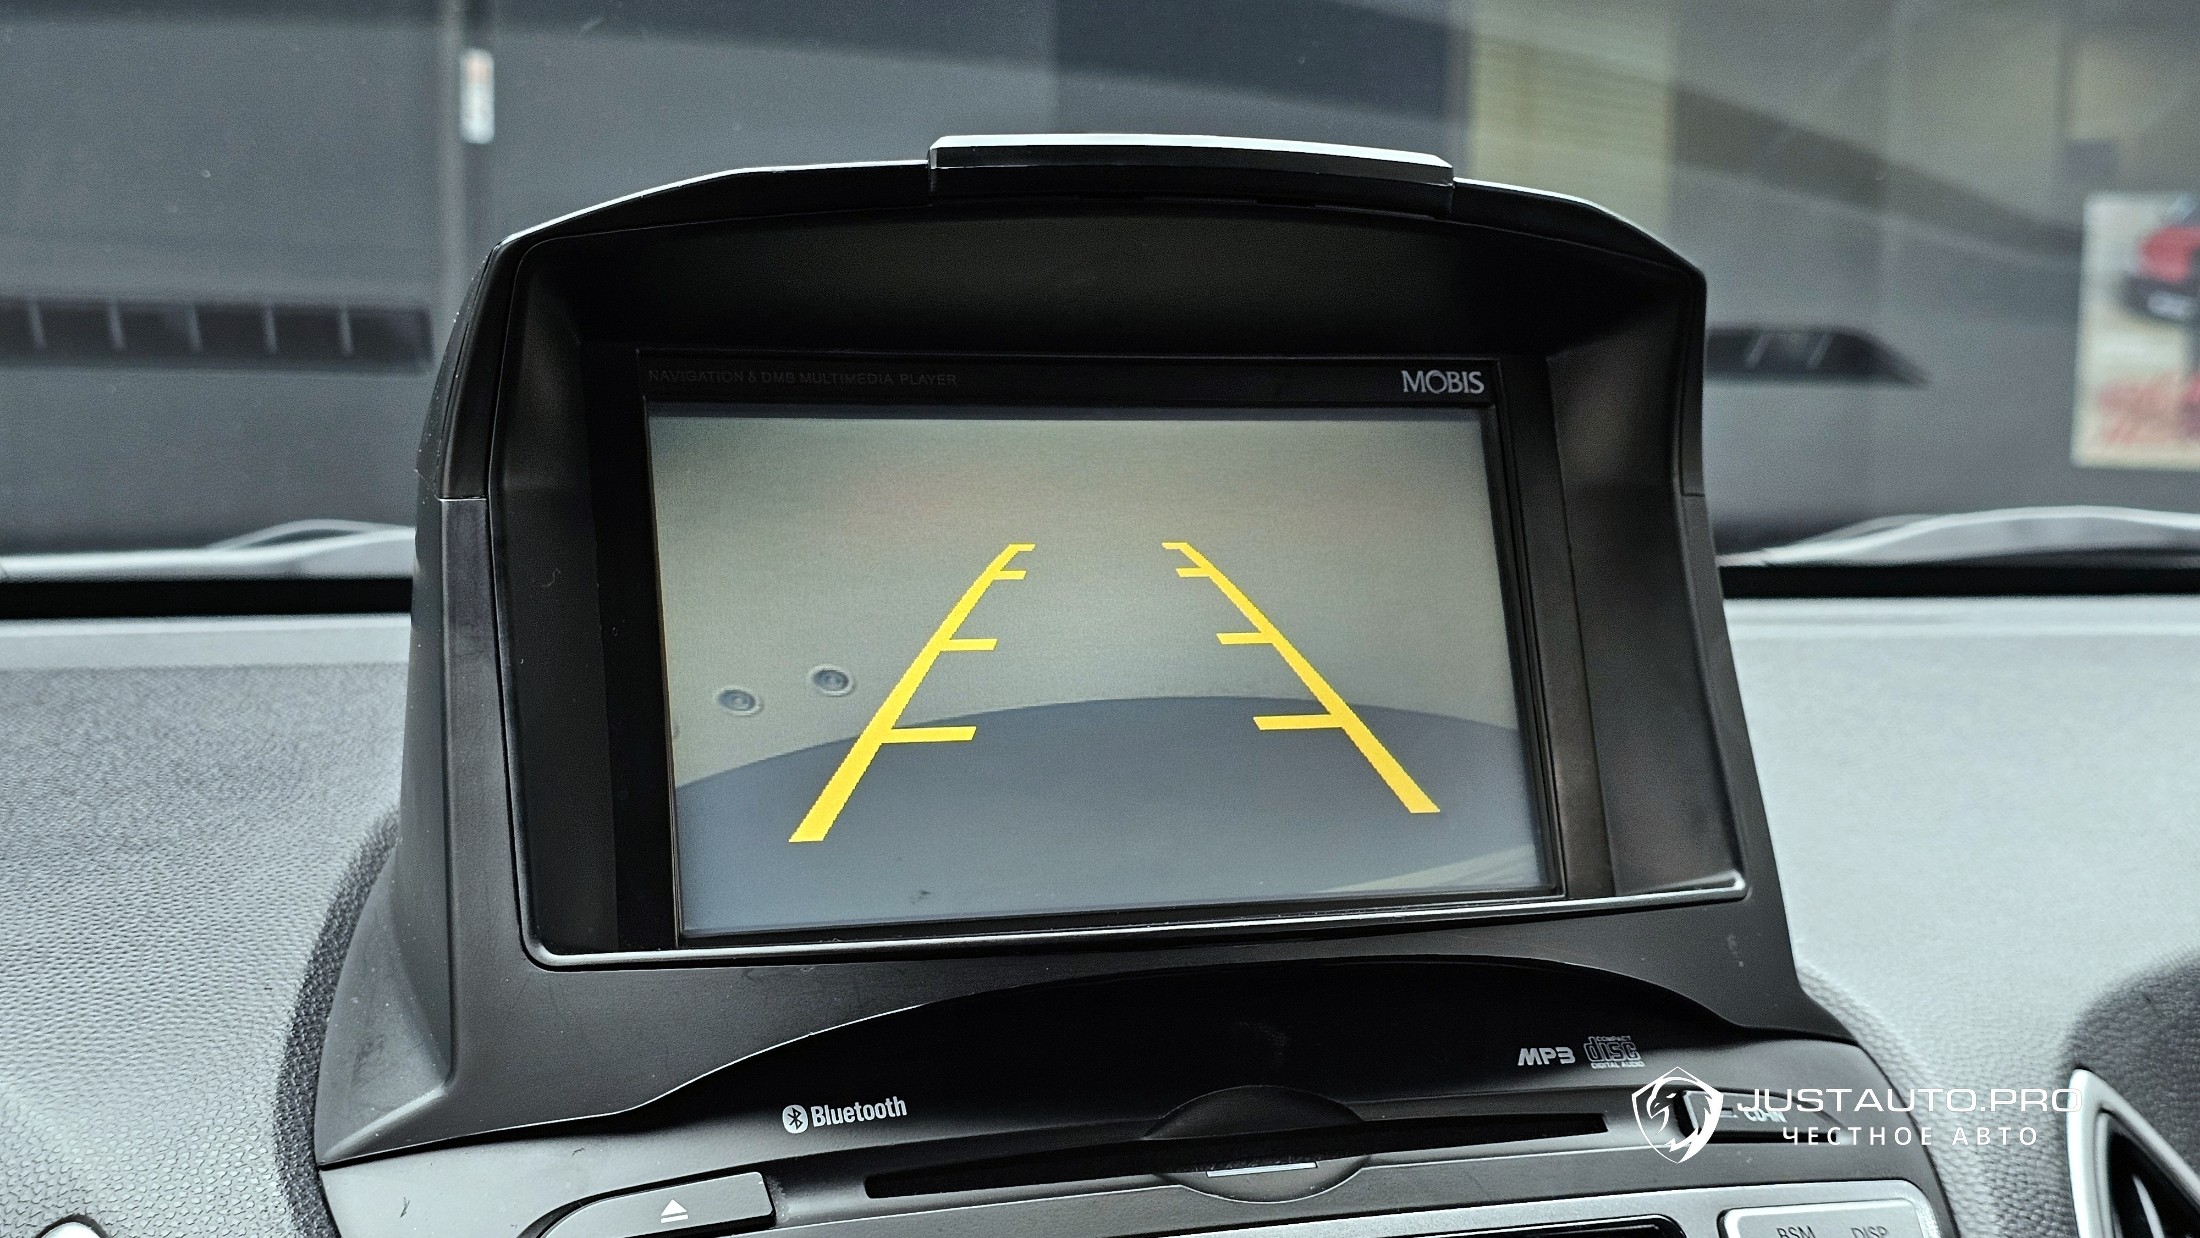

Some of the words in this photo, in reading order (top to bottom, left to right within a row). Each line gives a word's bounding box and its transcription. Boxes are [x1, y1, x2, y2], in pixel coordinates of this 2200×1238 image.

[648, 369, 745, 384] NAVIGATION
[748, 370, 759, 384] &
[761, 371, 797, 385] DMB
[800, 371, 894, 386] MULTIMEDIA
[899, 372, 957, 386] PLAYER
[1401, 369, 1485, 394] MOBIS
[1517, 1046, 1576, 1066] MP3
[1590, 1061, 1620, 1069] DIGITAL
[1621, 1060, 1646, 1068] AUDIO
[810, 1095, 908, 1128] Bluetooth
